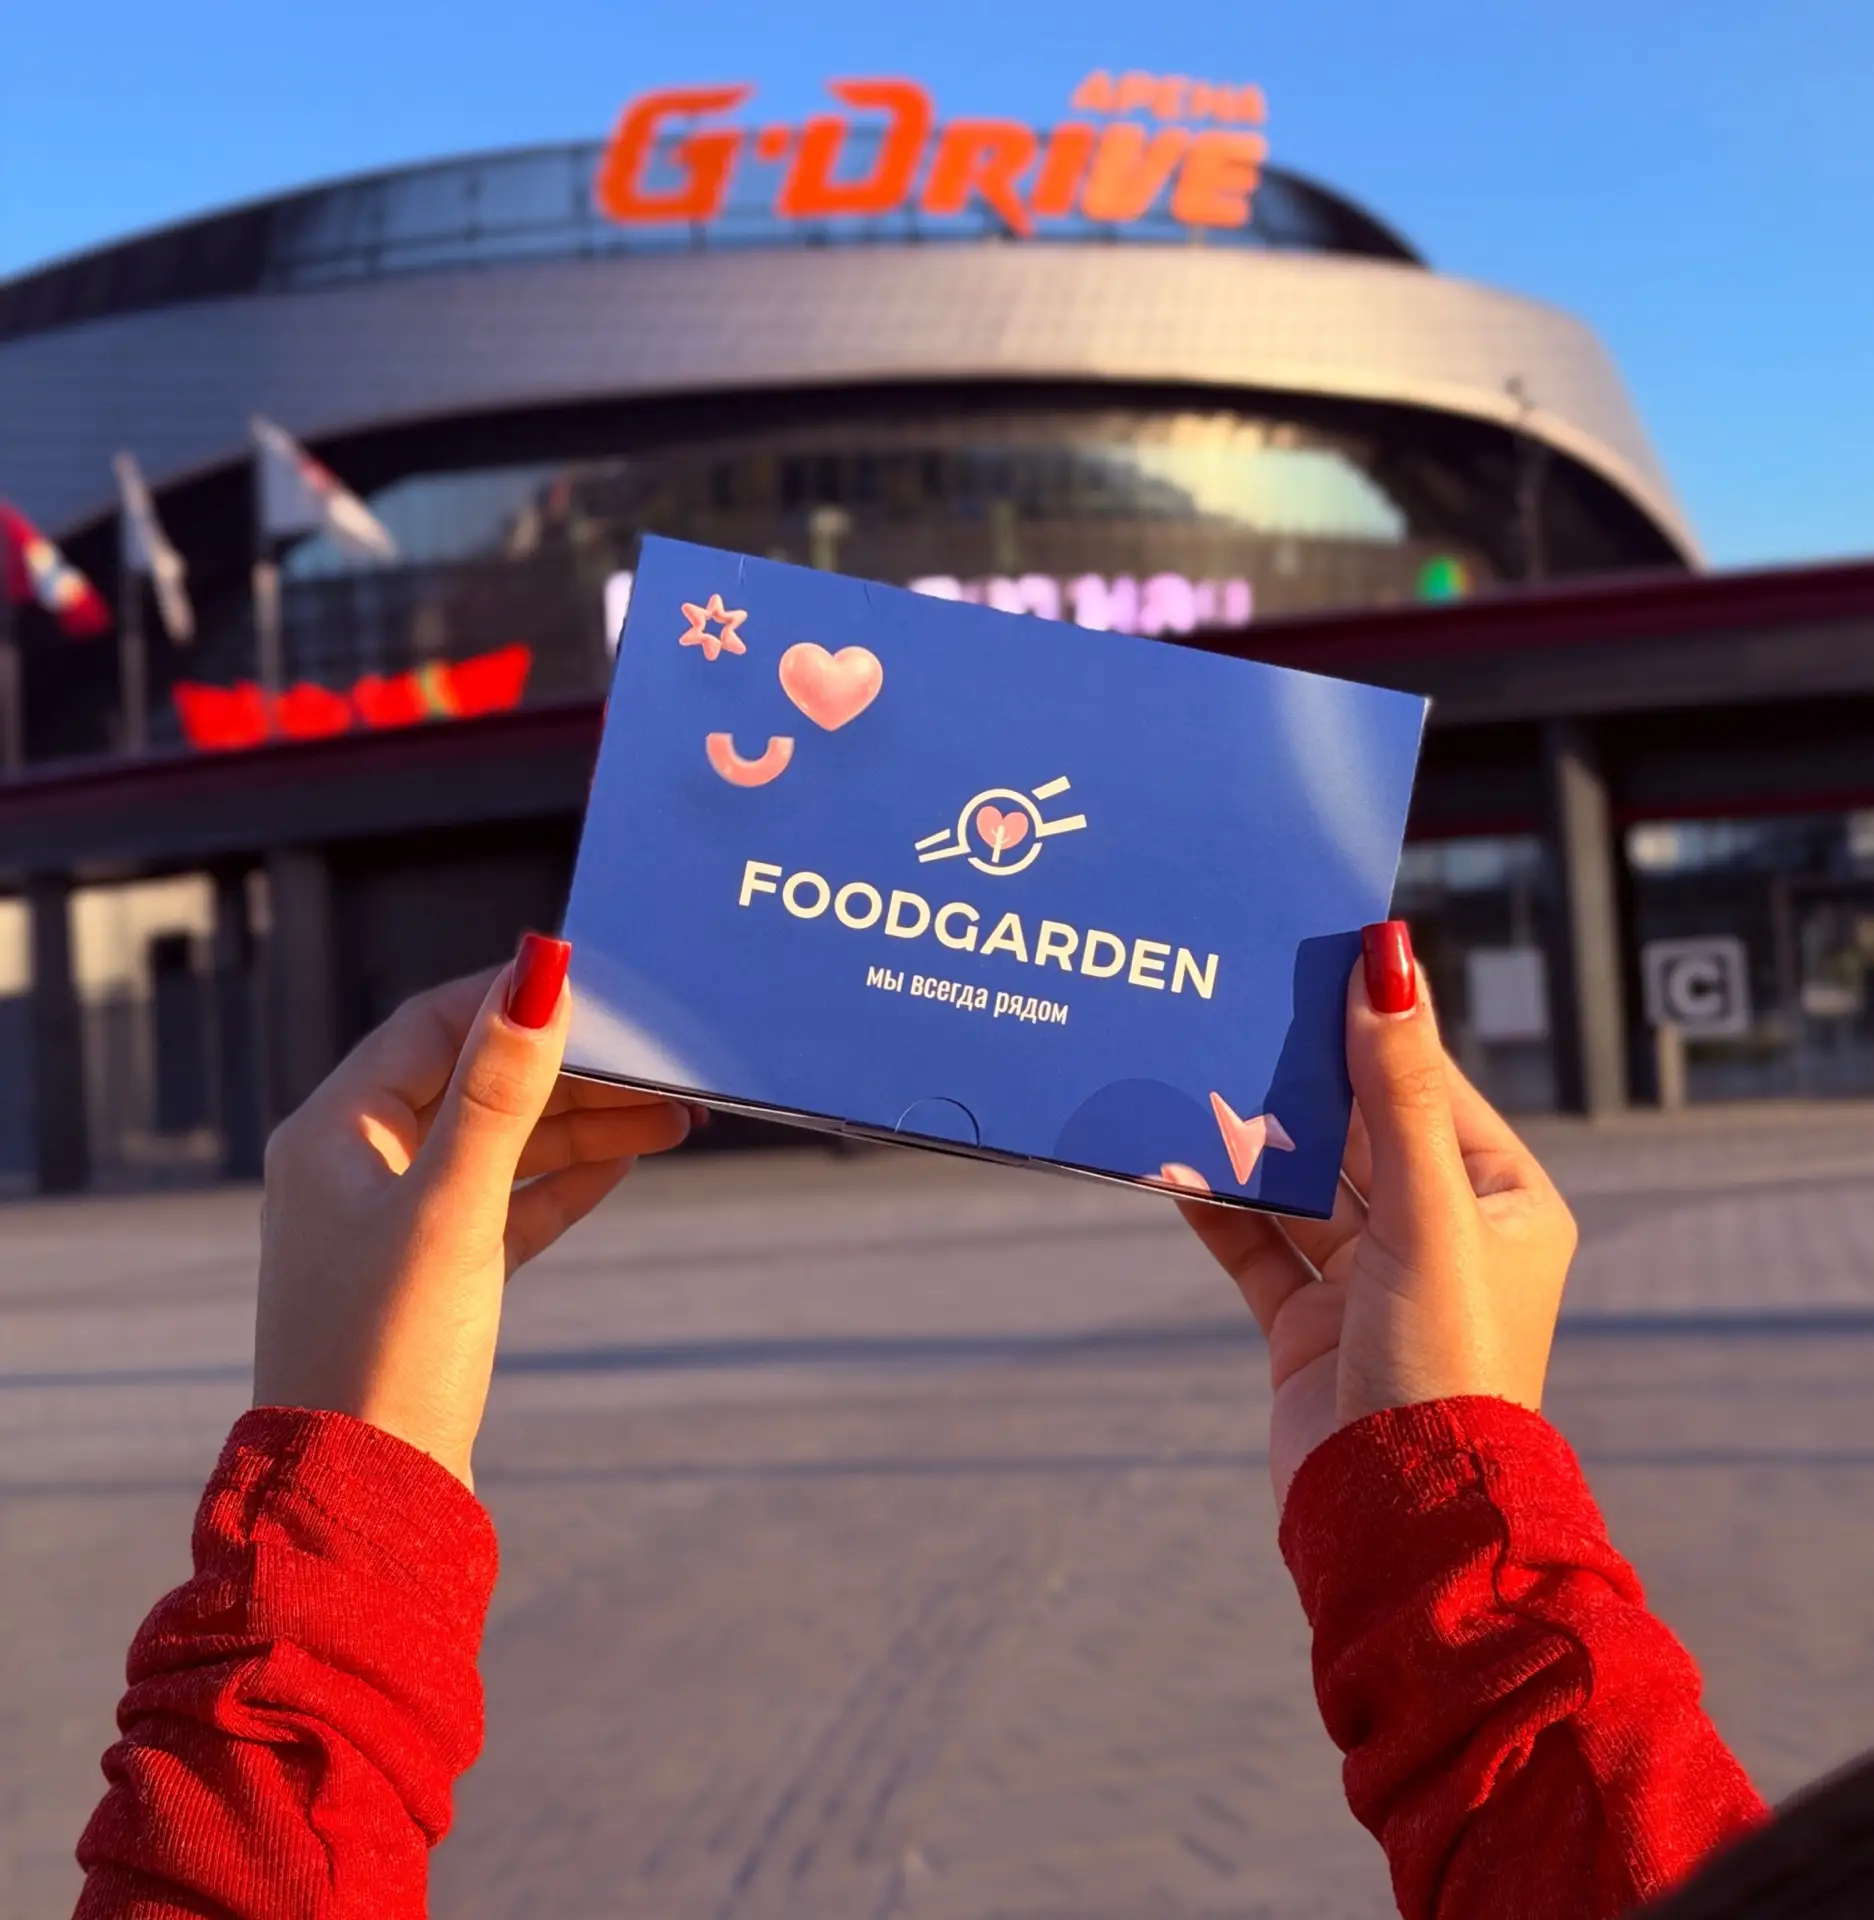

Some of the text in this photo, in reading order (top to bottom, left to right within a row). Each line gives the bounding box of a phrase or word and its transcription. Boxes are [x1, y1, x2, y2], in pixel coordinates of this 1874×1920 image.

[738, 859, 1220, 1001] FOODGARDEN
[866, 966, 1069, 1025] мы всегда рядом
